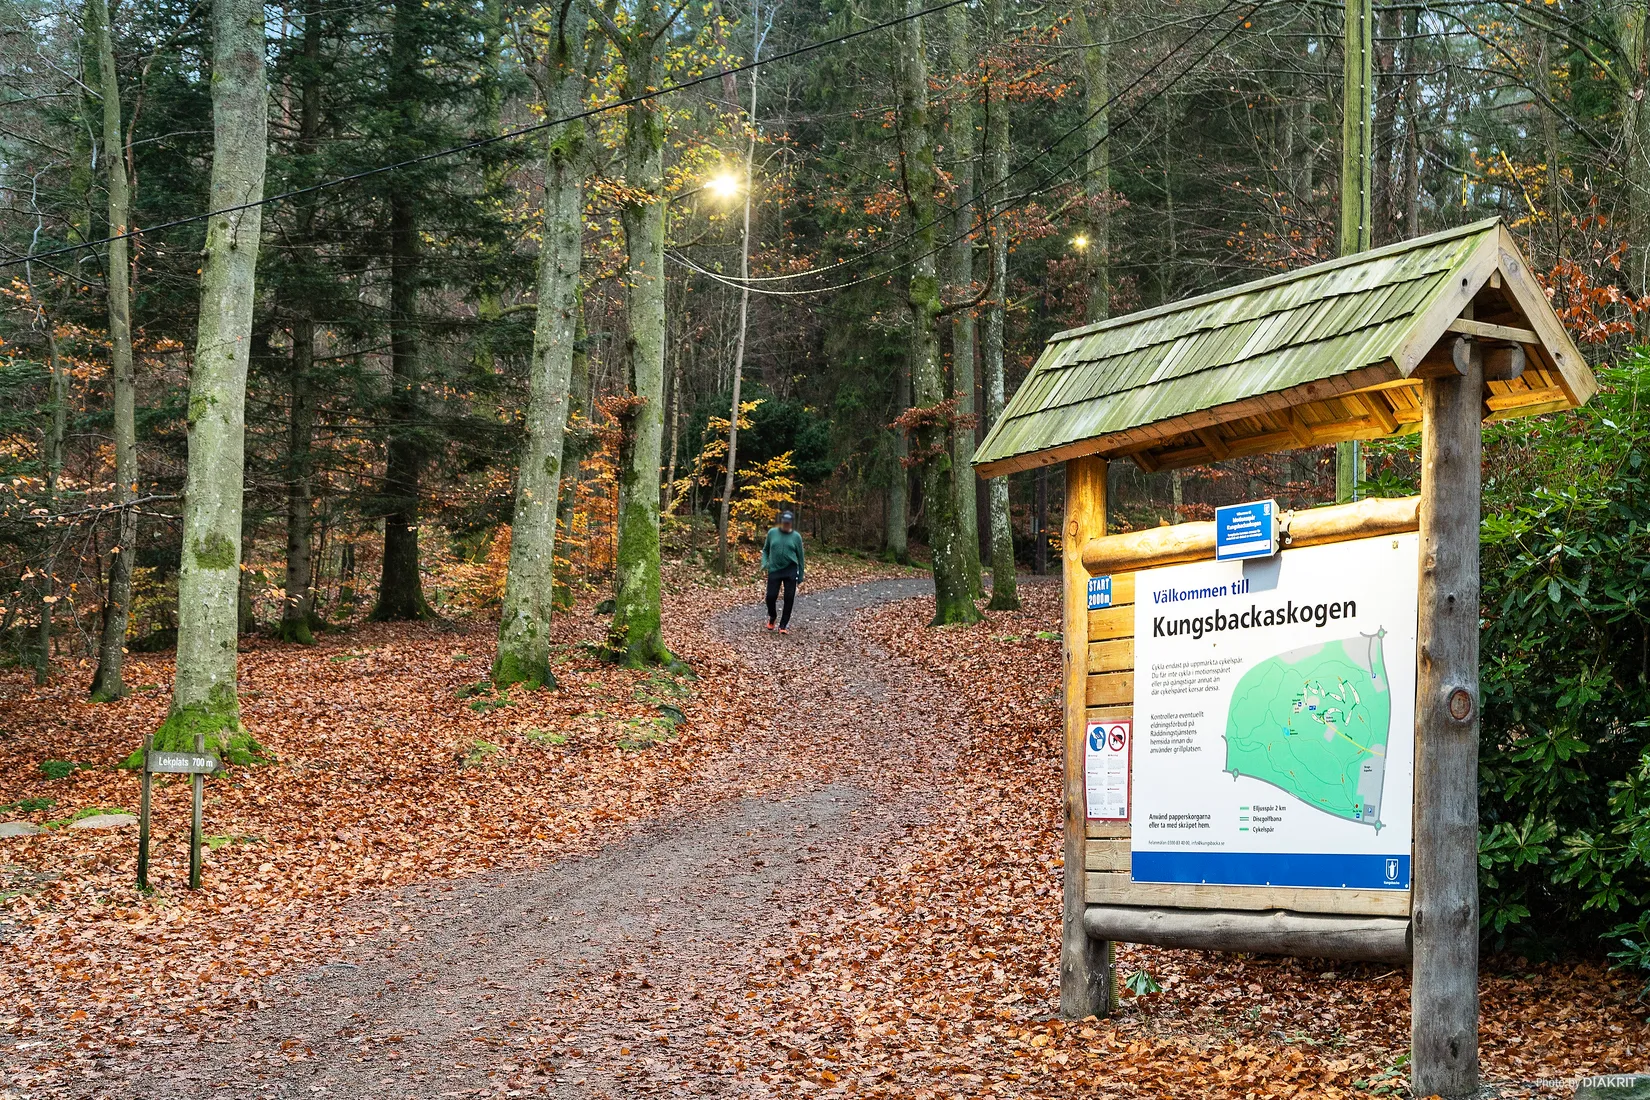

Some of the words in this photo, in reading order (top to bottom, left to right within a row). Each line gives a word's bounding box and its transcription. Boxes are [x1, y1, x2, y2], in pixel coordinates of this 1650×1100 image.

[1089, 578, 1109, 592] START
[1153, 584, 1227, 604] Välkommen
[1231, 579, 1249, 594] till
[1153, 600, 1357, 639] Kungsbackaskogen
[1182, 661, 1189, 669] på
[1190, 659, 1218, 668] uppmärkta
[1195, 666, 1231, 675] motionsspåret
[1163, 680, 1169, 688] på
[1170, 678, 1196, 687] gångstigar
[1160, 687, 1187, 696] cykelspåret
[1150, 720, 1187, 729] eldningsförbud
[1188, 719, 1194, 728] på
[1173, 745, 1202, 754] grillplatsen.
[158, 757, 189, 768] Lekplats
[192, 758, 205, 767] 700
[1169, 813, 1211, 821] papperskorgarna
